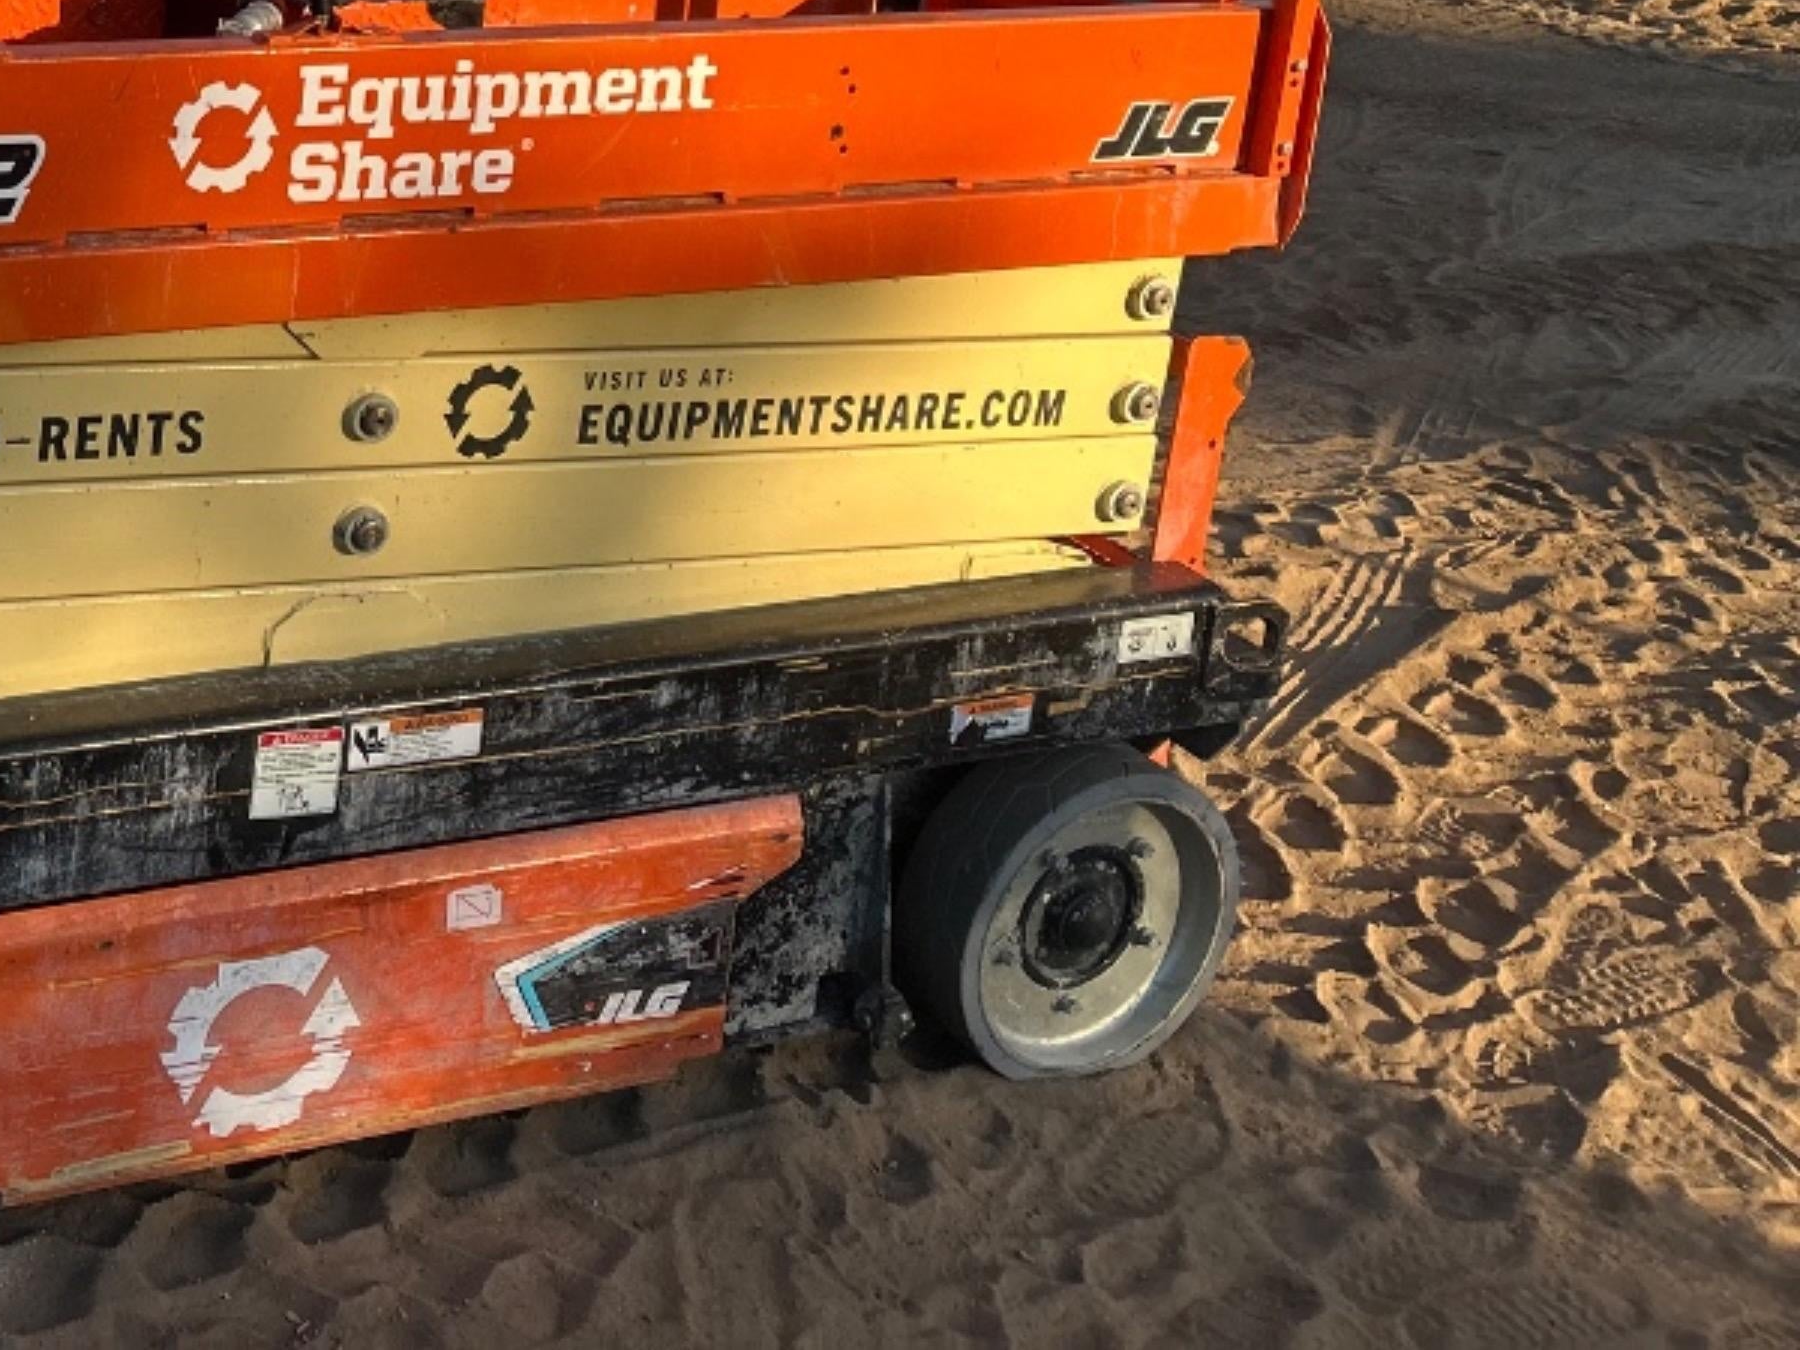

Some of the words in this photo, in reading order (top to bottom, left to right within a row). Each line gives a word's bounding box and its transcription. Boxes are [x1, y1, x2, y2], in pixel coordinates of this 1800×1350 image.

[296, 54, 718, 140] Equipment
[1090, 97, 1235, 162] JLG
[288, 141, 516, 204] Share
[584, 369, 647, 391] VISIT
[659, 368, 688, 388] US
[699, 368, 734, 387] AT:
[576, 389, 1067, 447] EQUIPMENTSHARE.COM
[596, 979, 692, 1026] JLG
